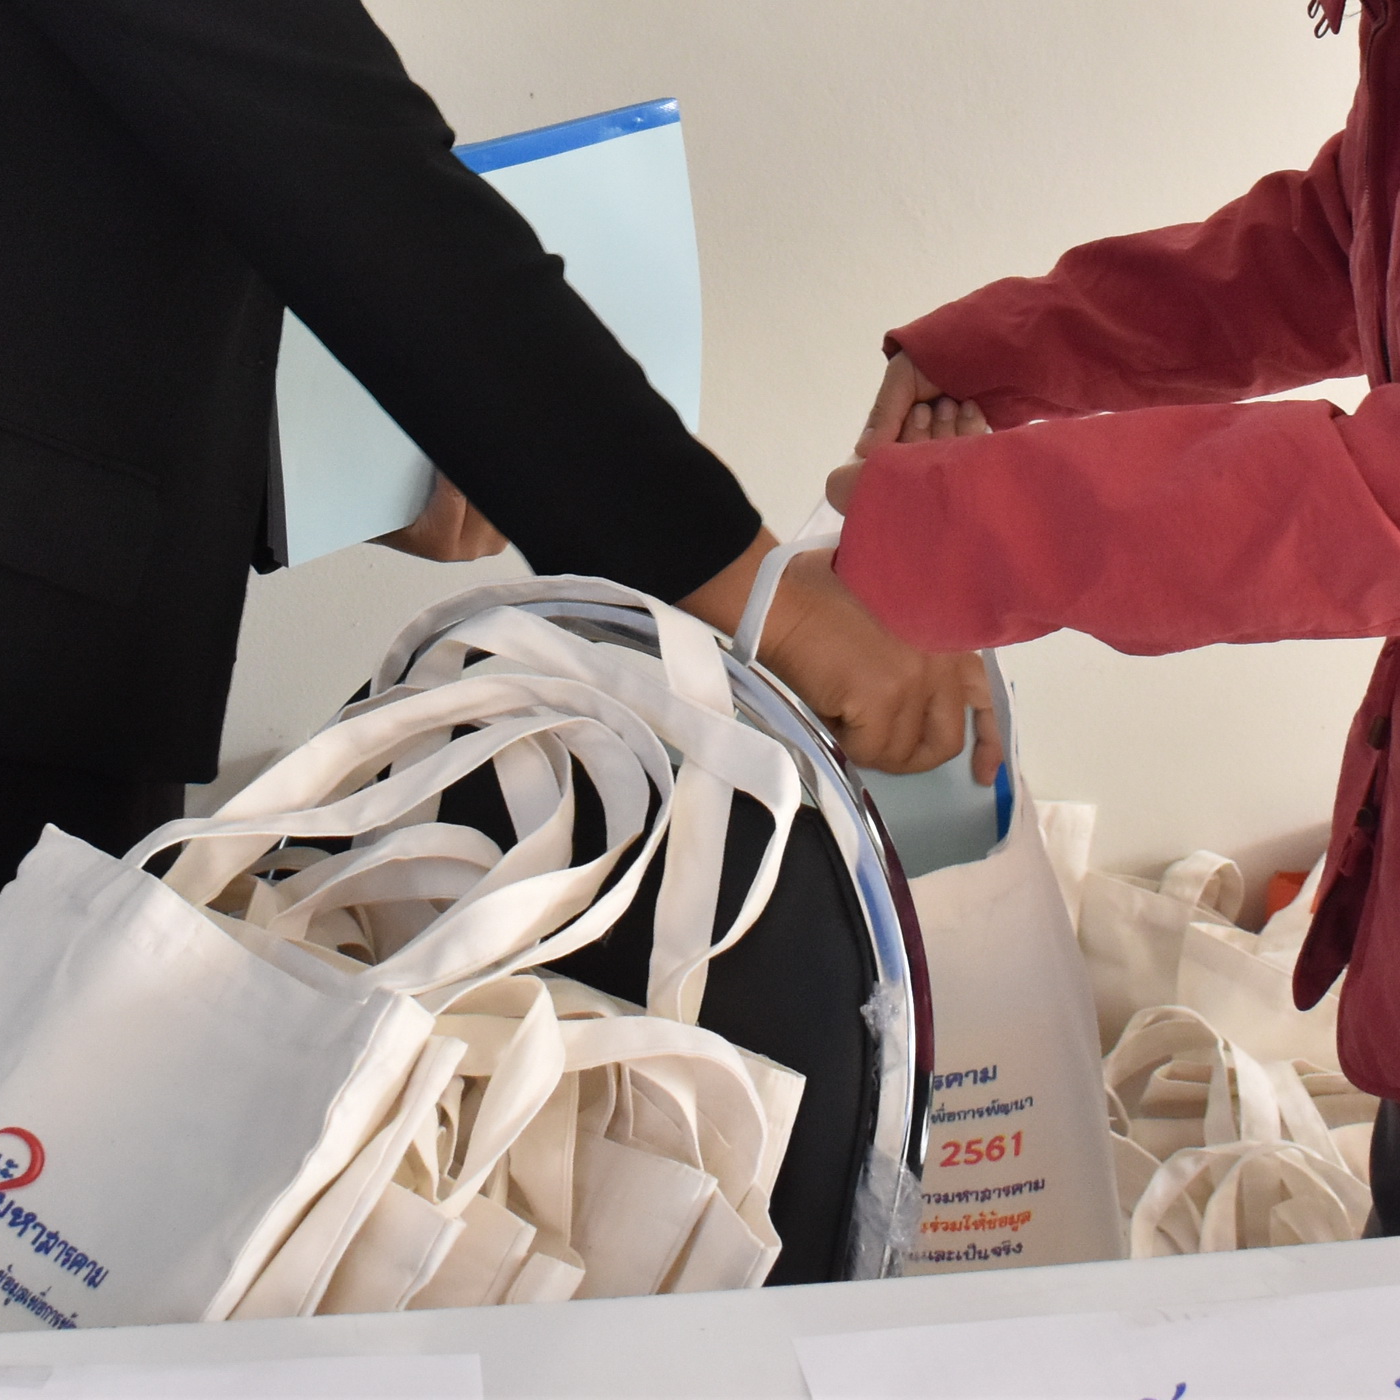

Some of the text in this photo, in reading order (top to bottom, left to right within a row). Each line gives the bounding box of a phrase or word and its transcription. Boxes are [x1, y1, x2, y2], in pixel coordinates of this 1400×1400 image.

[940, 1130, 1024, 1168] 2561
[921, 1177, 1046, 1204] าวมหาสารคาม
